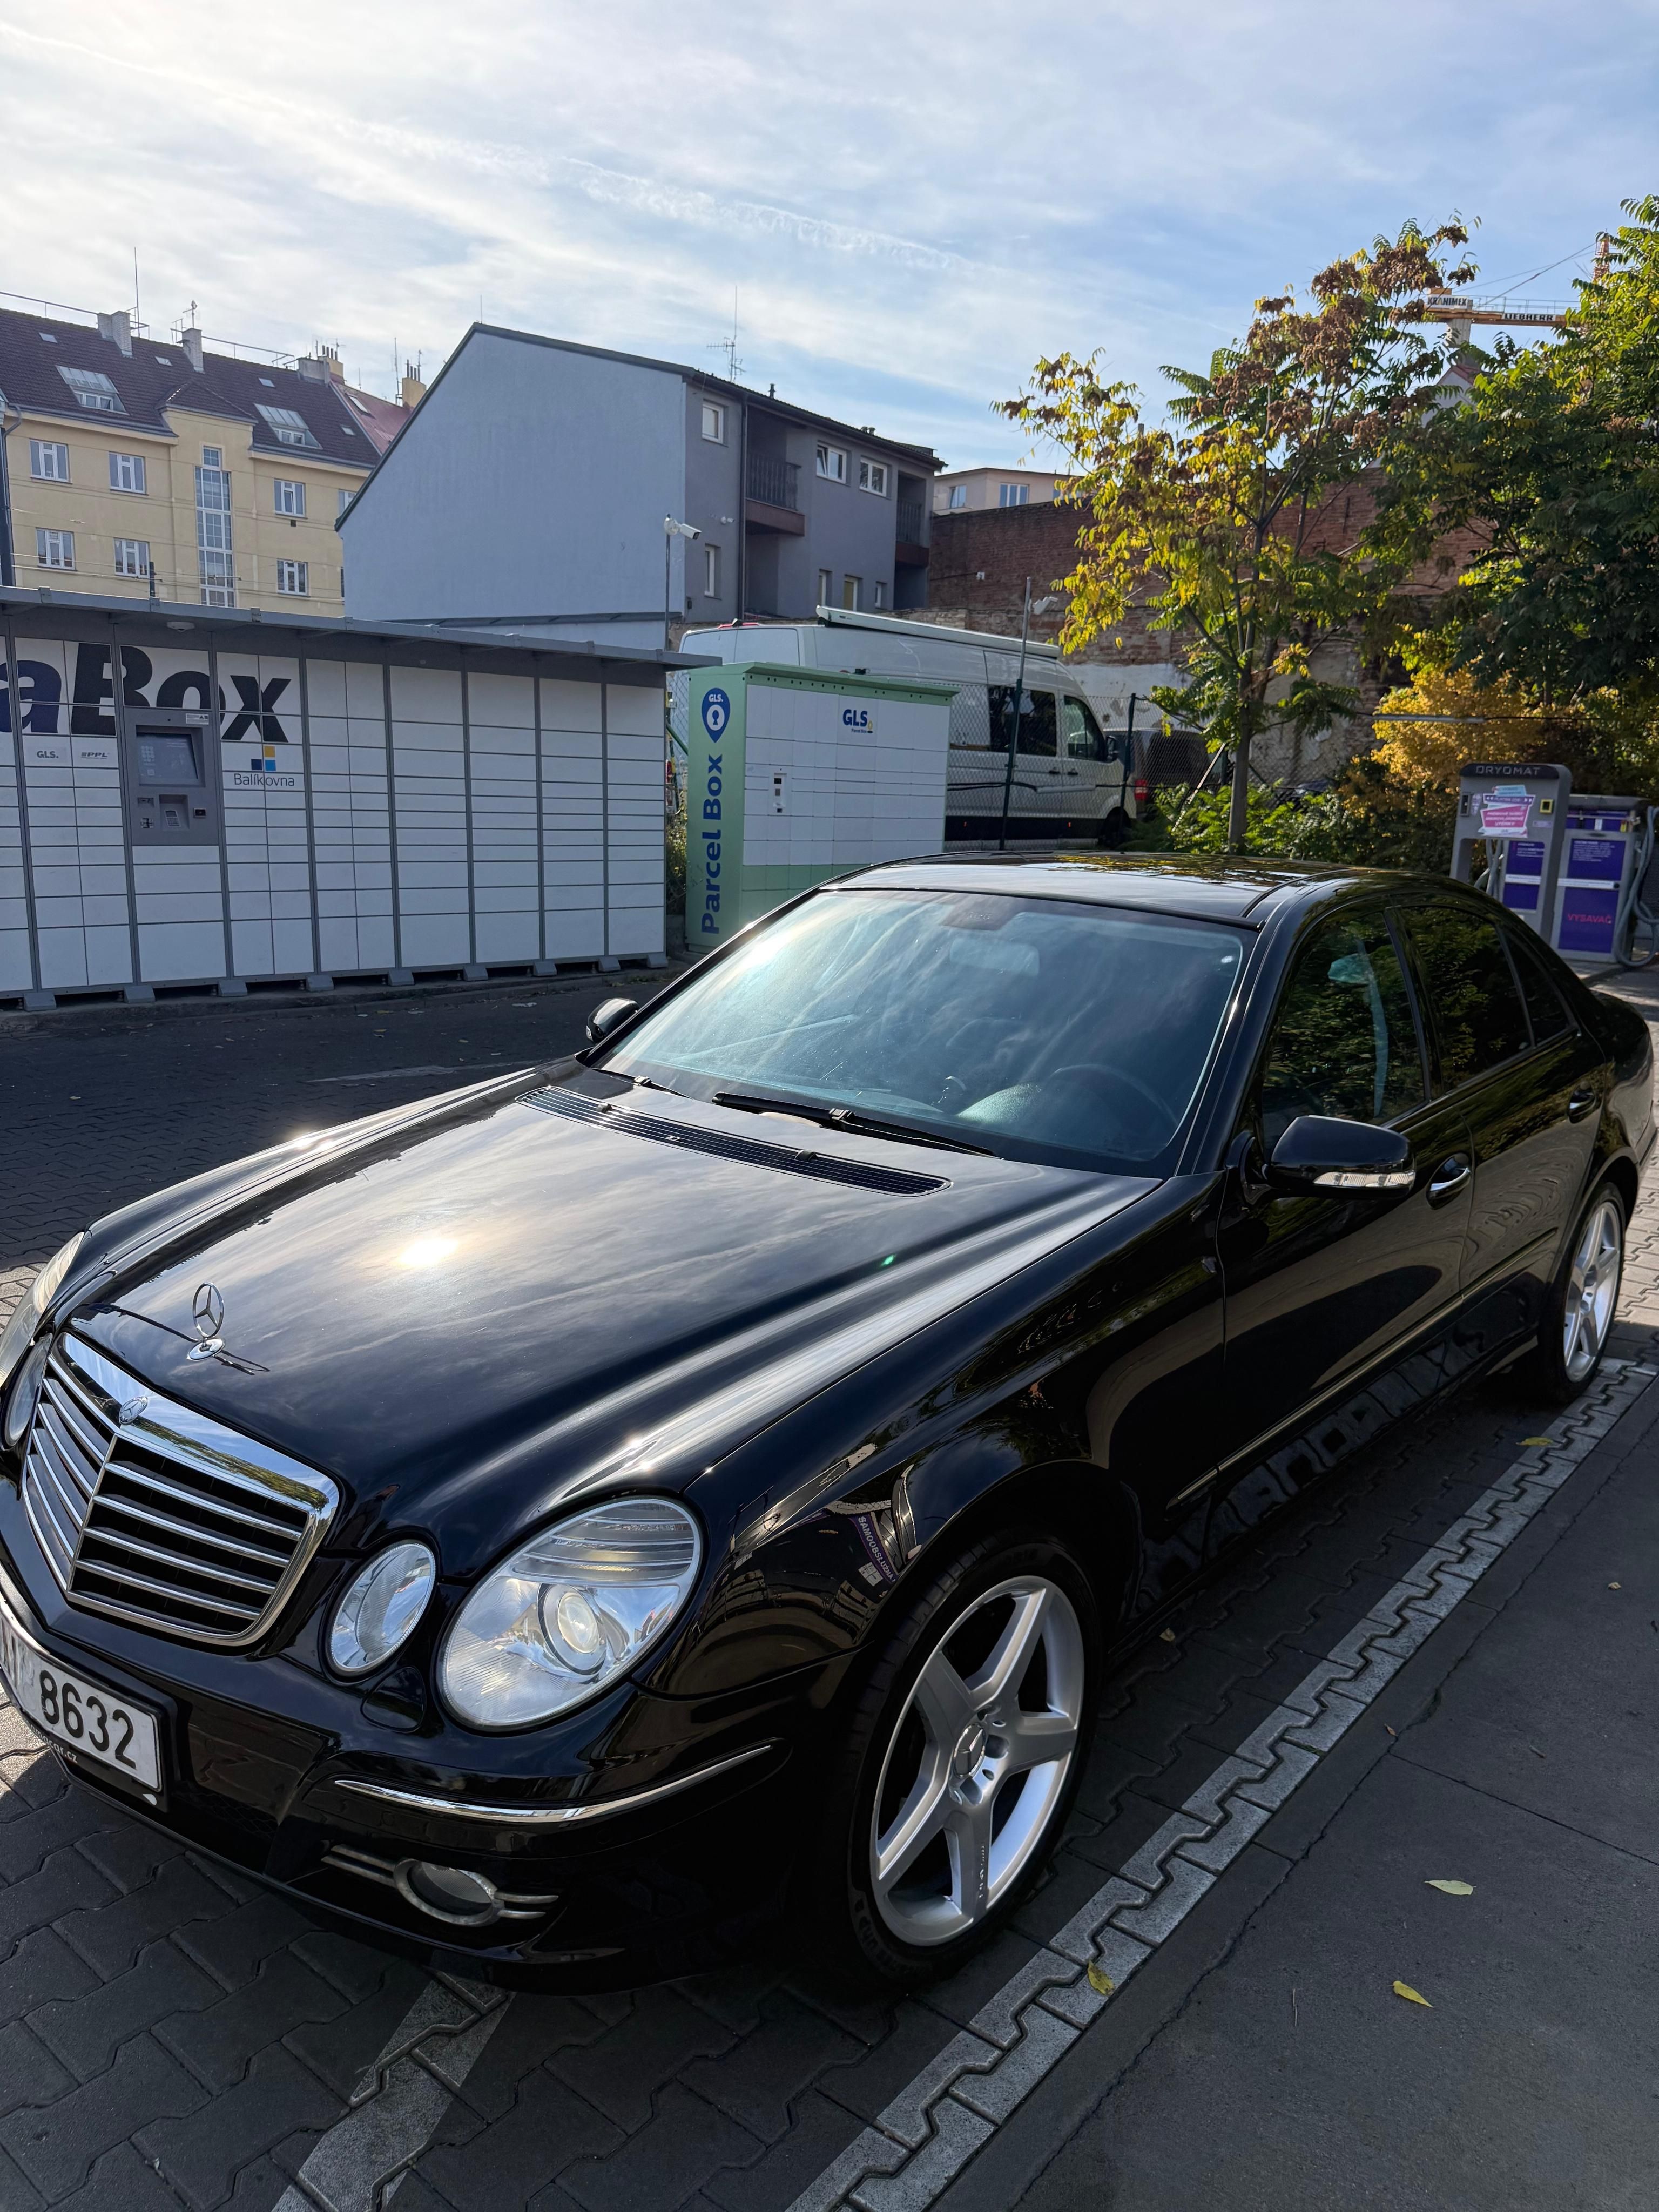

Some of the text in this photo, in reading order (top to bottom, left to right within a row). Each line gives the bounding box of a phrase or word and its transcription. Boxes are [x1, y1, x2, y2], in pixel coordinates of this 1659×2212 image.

[1504, 313, 1554, 321] LIEBHERR
[1475, 766, 1541, 775] DRYOMAT
[234, 773, 295, 786] Balíkovna
[702, 754, 723, 934] Parcel Box
[1568, 913, 1611, 924] VYSAVAČ
